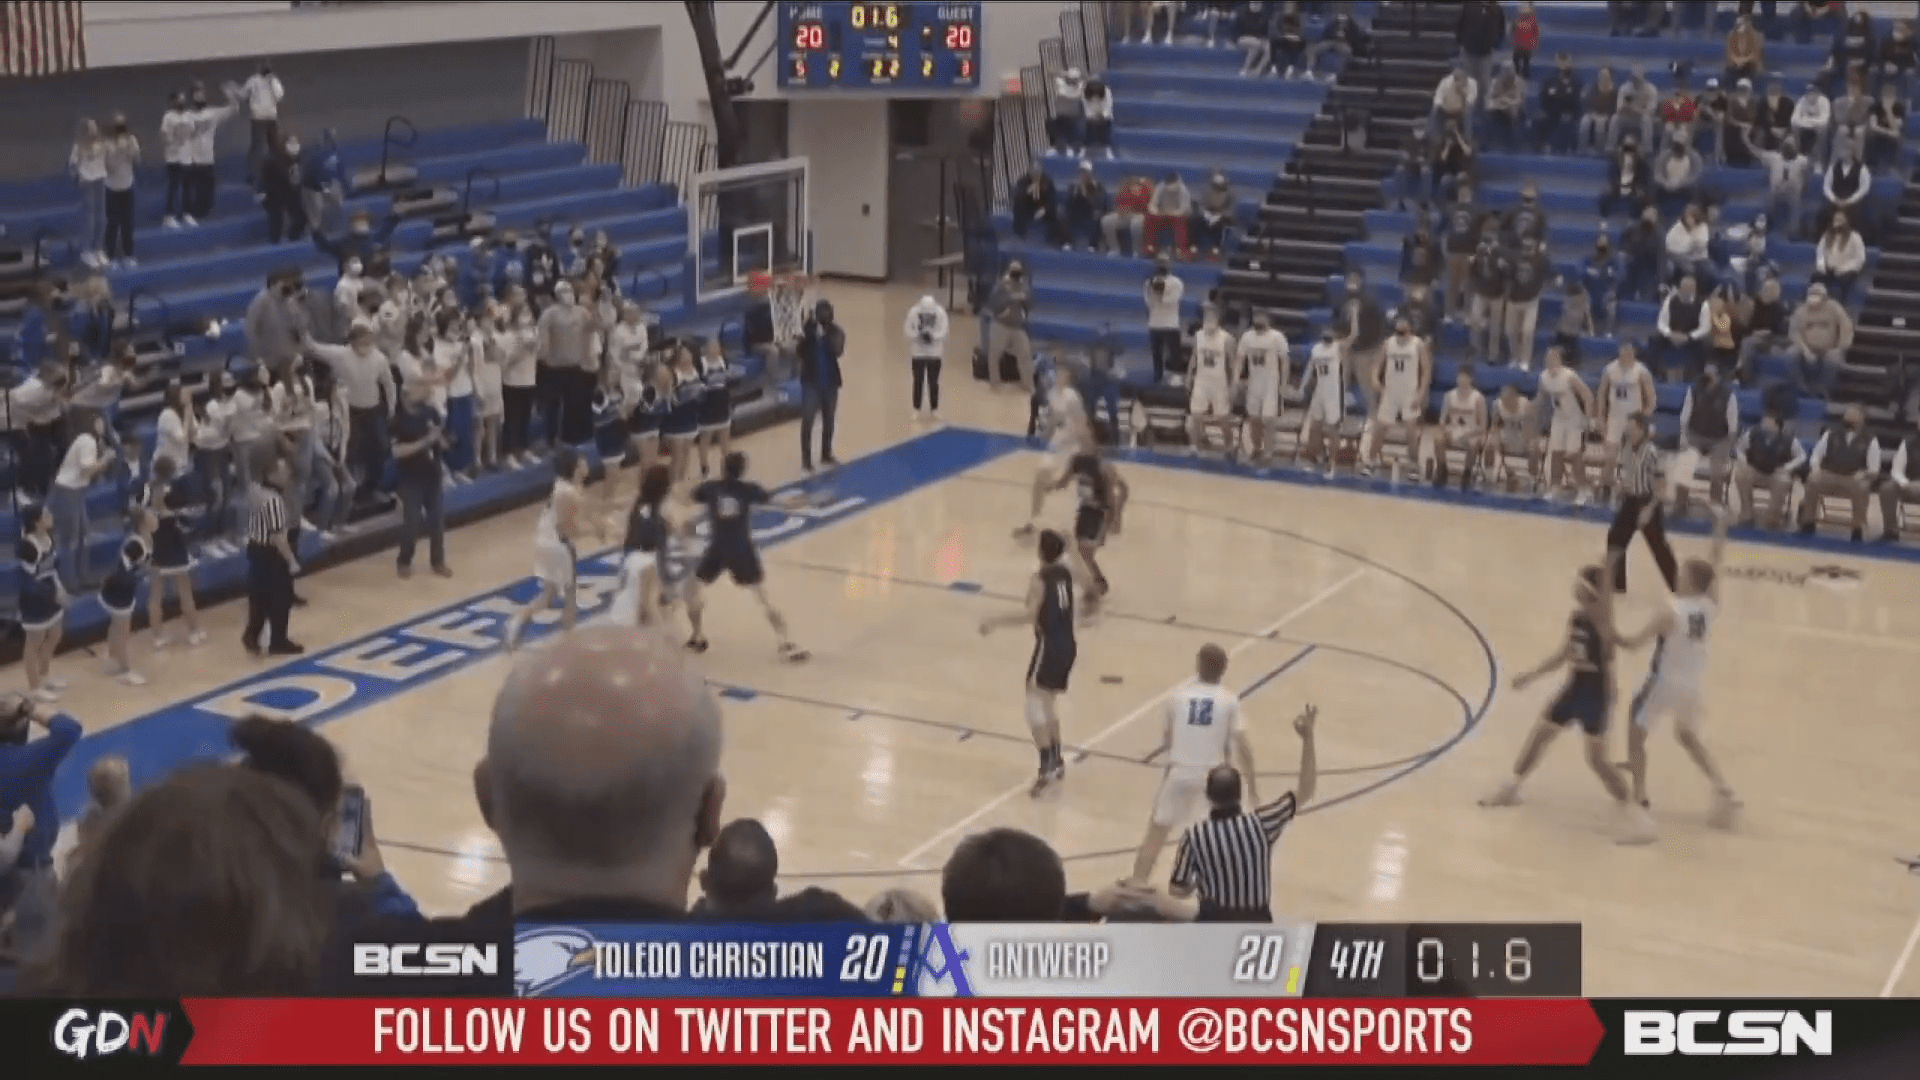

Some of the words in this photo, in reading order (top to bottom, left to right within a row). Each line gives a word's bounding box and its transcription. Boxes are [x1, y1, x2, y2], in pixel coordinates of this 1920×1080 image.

[796, 24, 823, 48] 20
[946, 25, 971, 48] 20
[1187, 698, 1213, 725] 12
